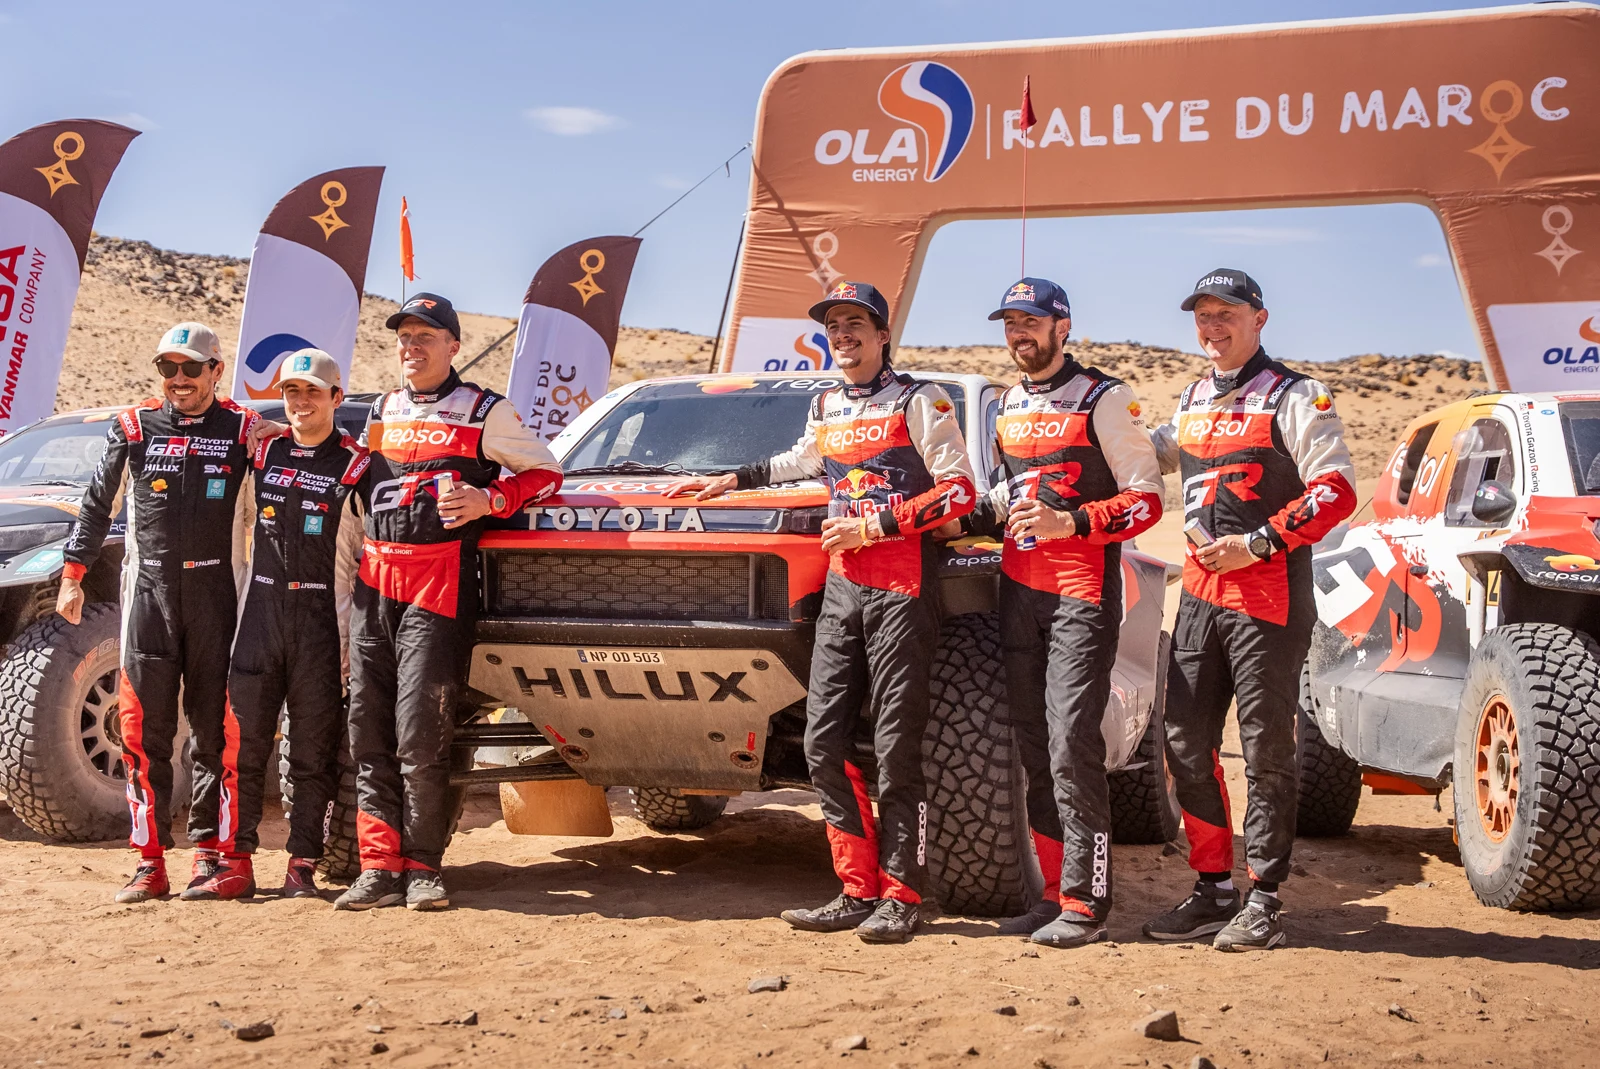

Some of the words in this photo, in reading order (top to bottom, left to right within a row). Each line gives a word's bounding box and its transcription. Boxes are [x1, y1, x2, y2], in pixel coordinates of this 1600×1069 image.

[1003, 99, 1210, 150] RALLYE
[1235, 92, 1314, 139] DU
[1339, 76, 1570, 133] MAROC
[814, 128, 918, 165] OLA
[852, 168, 918, 182] ENERGY
[19, 247, 47, 324] COMPANY
[1543, 346, 1600, 365] OLA
[537, 361, 552, 388] DU
[772, 380, 839, 391] rep
[1086, 380, 1111, 403] sparco
[476, 395, 497, 418] sparco
[1317, 413, 1337, 421] repso
[1003, 417, 1070, 442] repsol
[1184, 415, 1252, 440] repsol
[1522, 411, 1533, 437] TOYOTA
[193, 436, 234, 445] TOYOTA
[381, 427, 458, 447] repsol
[824, 420, 890, 450] repsol
[147, 443, 186, 457] GR
[189, 450, 227, 459] Racing
[190, 443, 229, 451] GAZOO
[1526, 437, 1537, 466] GAZOO
[144, 464, 180, 472] HILUX
[300, 470, 336, 482] TOYOTA
[263, 473, 294, 487] GR
[294, 481, 326, 493] Racing
[296, 477, 330, 487] GAZOO
[1530, 465, 1539, 493] Racing
[261, 492, 286, 502] HILUX
[1183, 462, 1264, 518] GR
[526, 507, 706, 532] TOYOTA
[947, 555, 1002, 567] repso
[1536, 571, 1599, 583] repsol
[590, 651, 608, 662] NP
[634, 652, 661, 663] 503
[511, 667, 758, 702] HILUX
[322, 800, 335, 844] sparco
[917, 801, 927, 866] sparco
[1092, 832, 1108, 898] sparco
